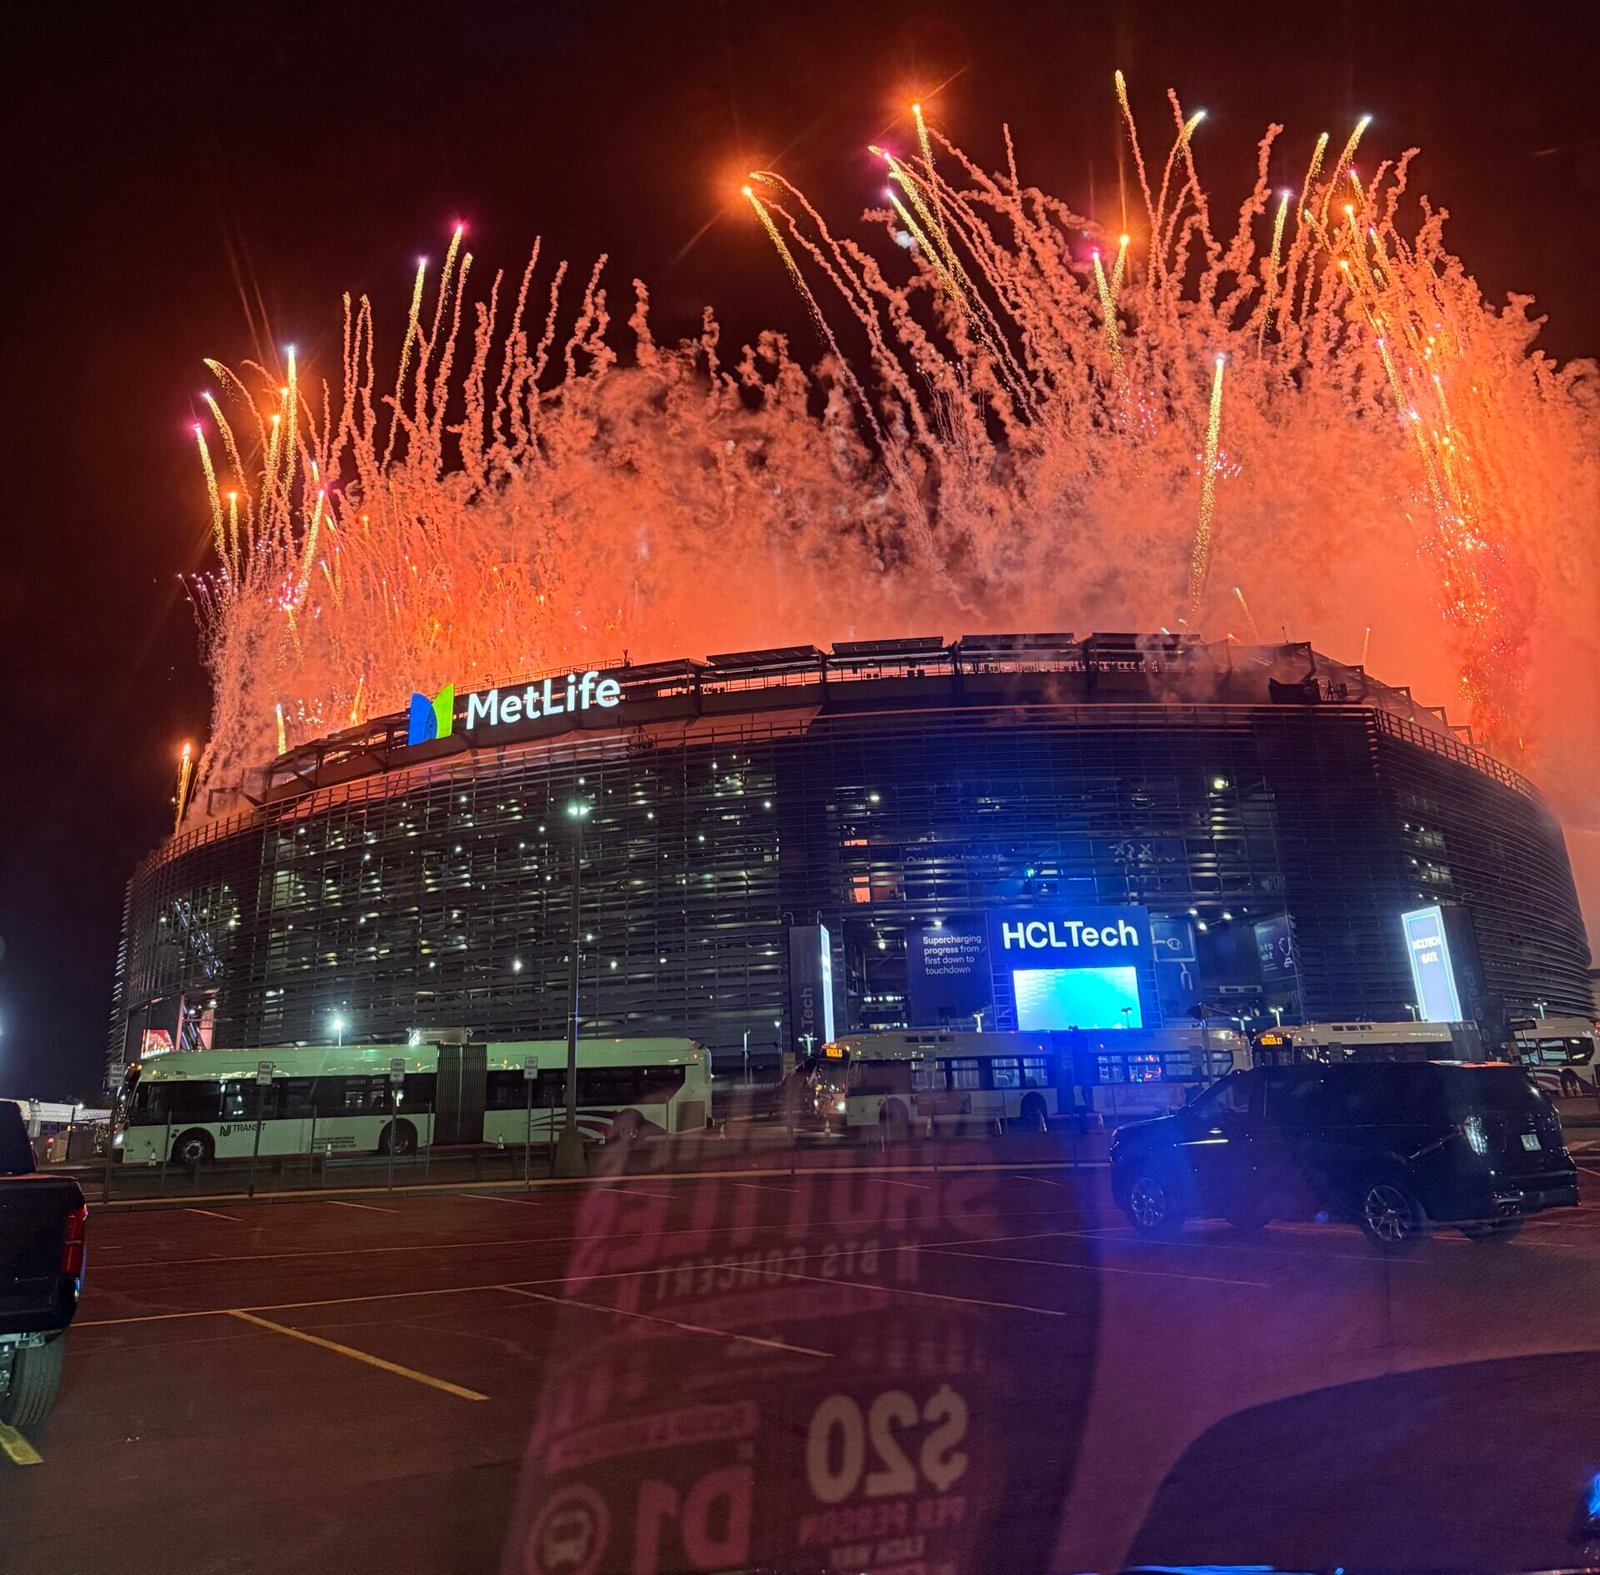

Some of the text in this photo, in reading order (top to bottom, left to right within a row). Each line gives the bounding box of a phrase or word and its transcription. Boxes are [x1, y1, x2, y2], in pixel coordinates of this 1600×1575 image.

[466, 671, 621, 730] MetLife
[922, 934, 982, 946] Supercharging
[1002, 920, 1139, 950] HCLTech
[924, 944, 980, 956] progress from
[925, 955, 975, 965] first down to
[925, 965, 971, 975] touchdown
[219, 1123, 267, 1137] NJ TRANST
